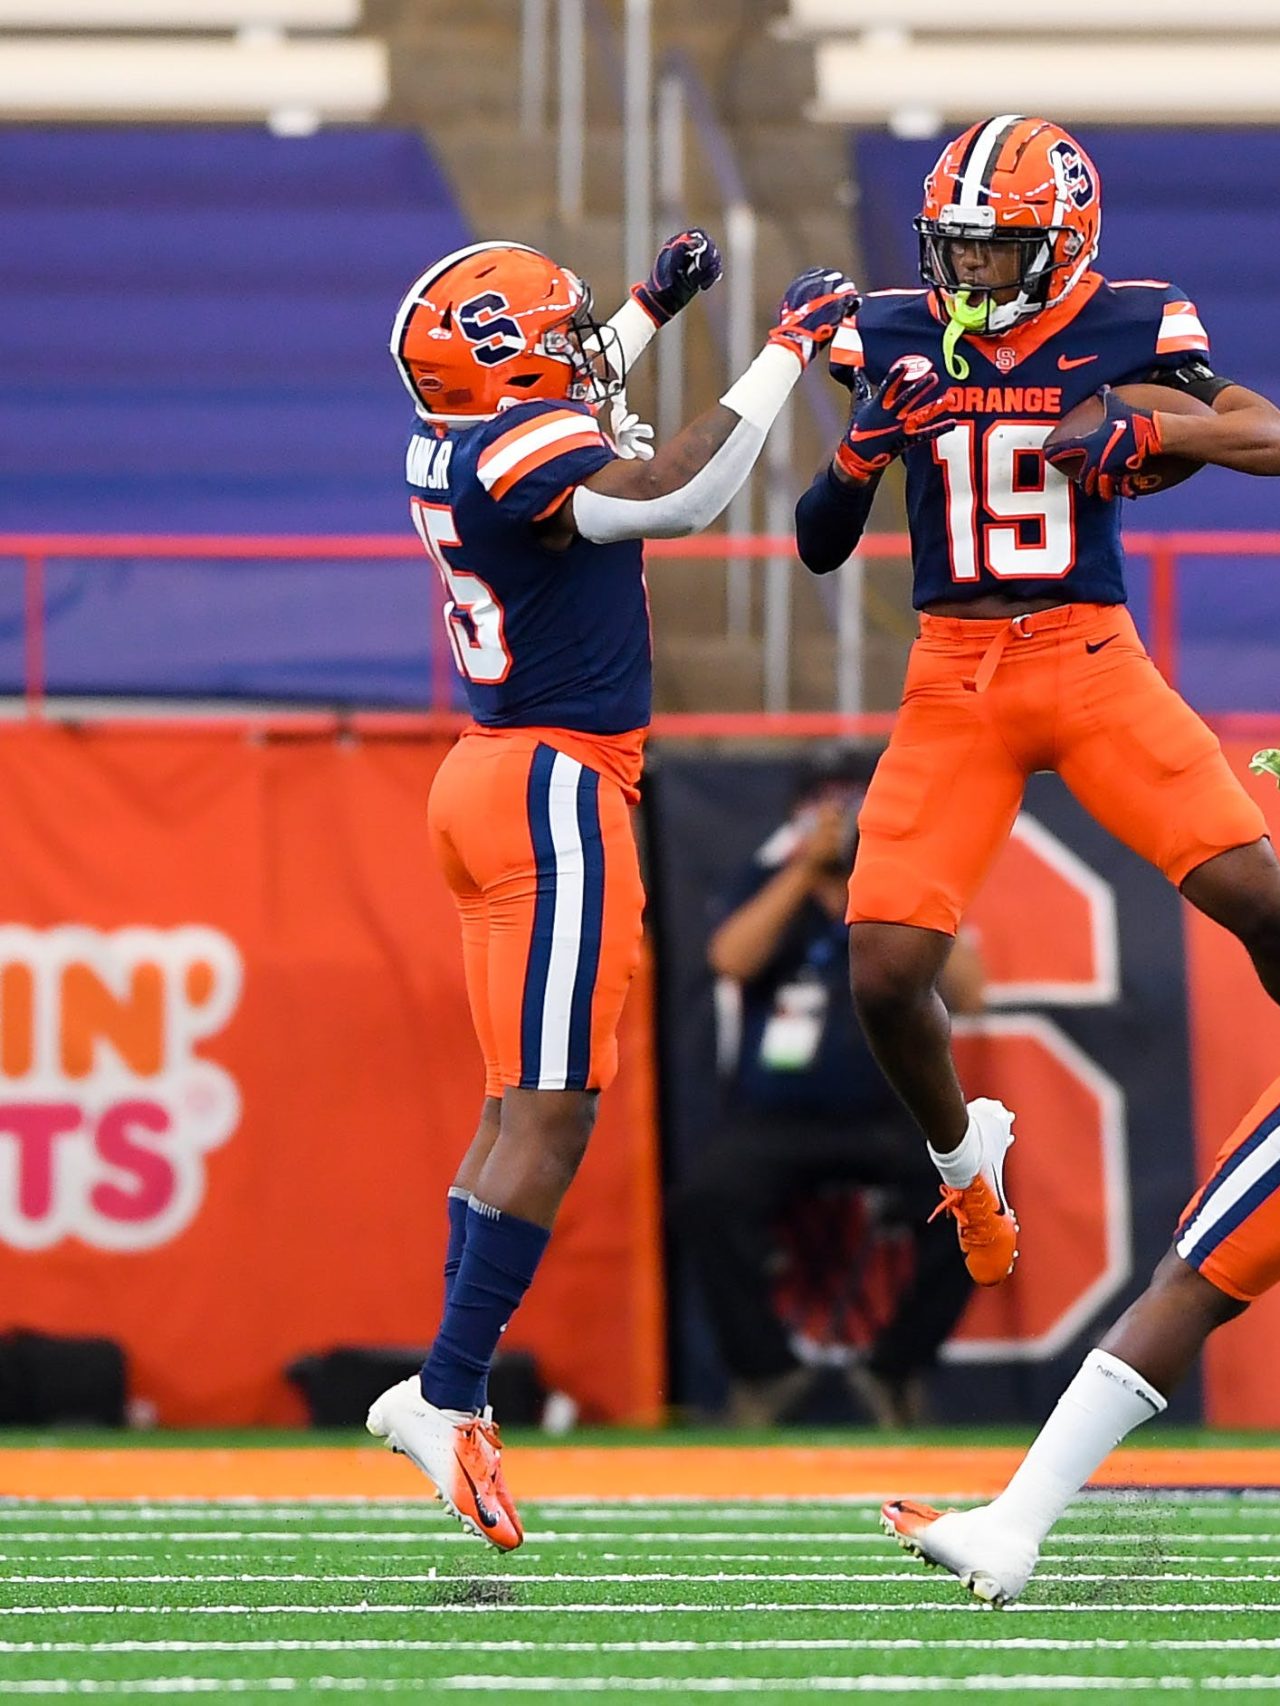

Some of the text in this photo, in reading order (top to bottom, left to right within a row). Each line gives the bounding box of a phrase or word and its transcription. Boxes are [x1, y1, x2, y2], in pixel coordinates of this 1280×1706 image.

[459, 292, 526, 366] S
[996, 347, 1015, 370] S
[949, 387, 1062, 413] ORANGE
[934, 420, 1075, 582] 19
